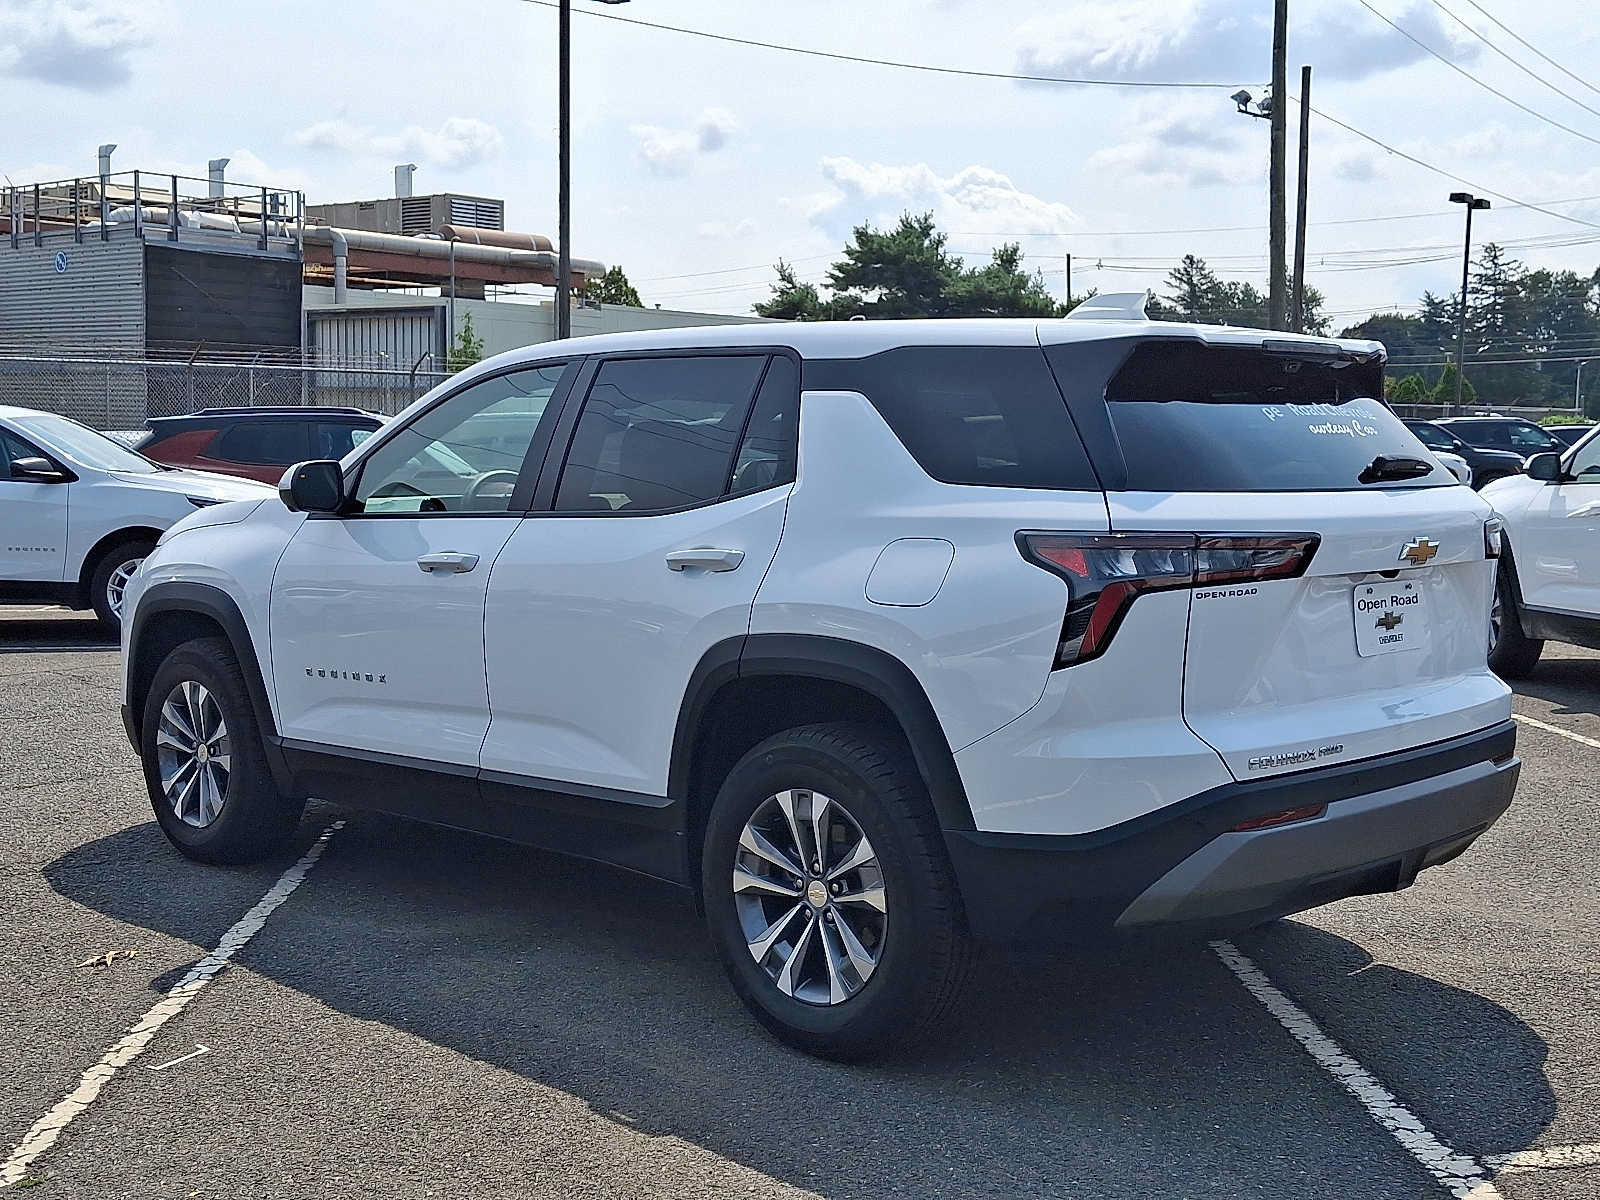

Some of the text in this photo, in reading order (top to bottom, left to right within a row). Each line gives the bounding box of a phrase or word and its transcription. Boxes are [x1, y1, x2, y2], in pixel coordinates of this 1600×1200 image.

[1195, 588, 1258, 600] OPEN ROAD
[1357, 593, 1419, 613] Open Road
[305, 667, 387, 684] EQUINOX
[1247, 749, 1317, 771] EQUINOX
